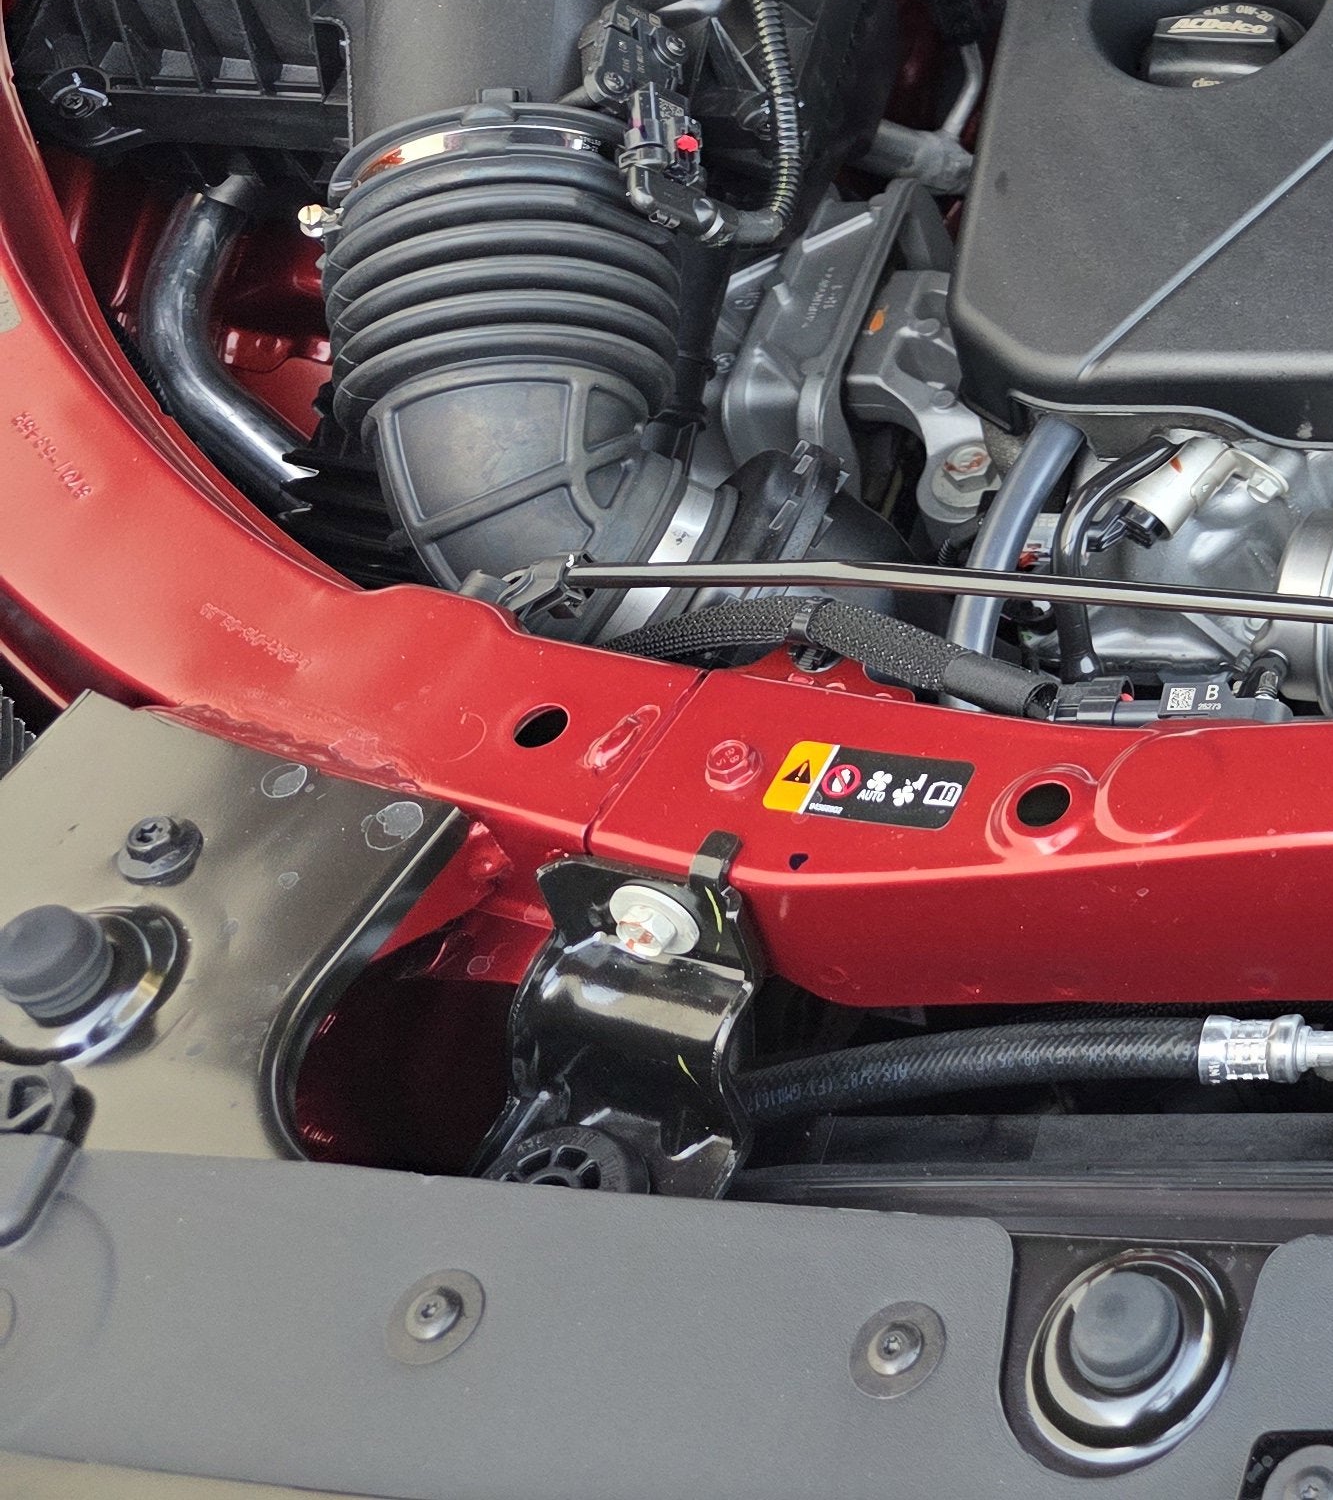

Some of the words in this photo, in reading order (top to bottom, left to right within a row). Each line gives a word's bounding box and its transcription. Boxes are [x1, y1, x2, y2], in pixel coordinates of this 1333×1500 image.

[1203, 4, 1230, 17] SAE
[1235, 5, 1275, 23] 0W-20
[1169, 18, 1269, 35] ACDelco
[1204, 684, 1220, 701] B
[856, 789, 885, 803] AUTO
